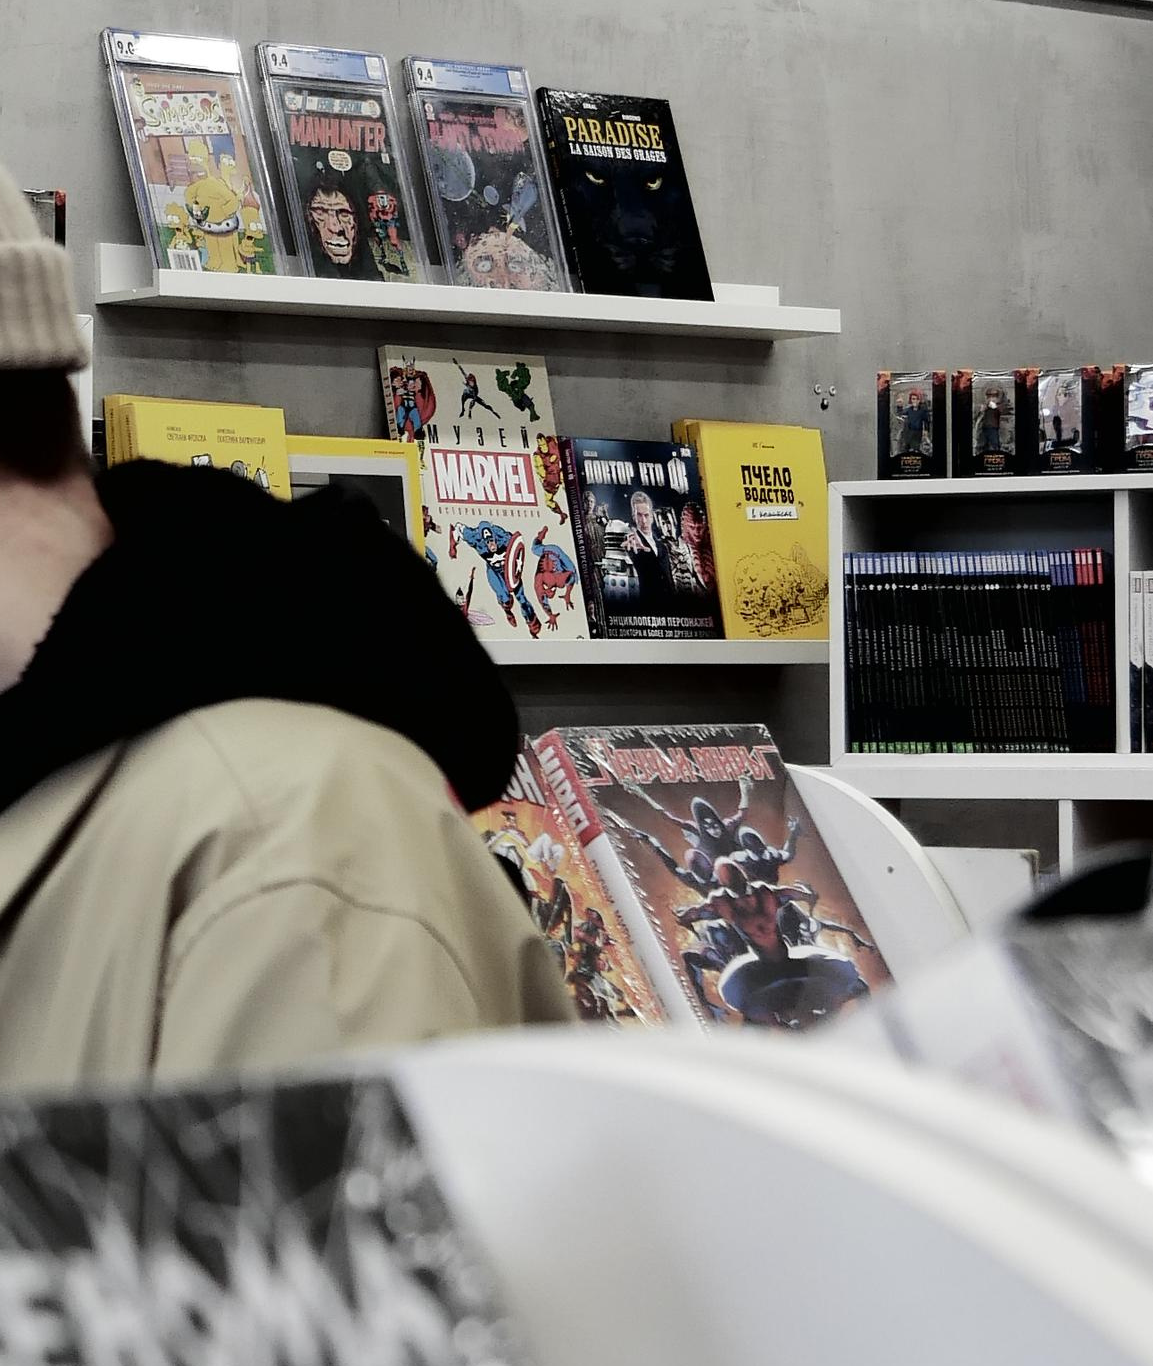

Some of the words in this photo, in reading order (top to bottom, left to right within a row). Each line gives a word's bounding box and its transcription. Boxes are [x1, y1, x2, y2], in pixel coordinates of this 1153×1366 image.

[271, 53, 288, 68] 9.4
[417, 67, 433, 82] 9.4
[289, 115, 387, 153] MANHUNTER
[563, 116, 664, 150] PARADISE
[569, 142, 583, 156] LA
[583, 144, 614, 159] SAISON
[614, 146, 633, 160] DES
[427, 423, 530, 449] МУЗЕЙ
[432, 452, 537, 504] MARVEL
[584, 460, 635, 486] ДОКТОР
[638, 461, 666, 488] КТО
[740, 464, 792, 488] ПЧЕЛО
[743, 487, 795, 504] ВОДСТВО
[608, 615, 667, 628] ЭНЦИКЛОПЕДИЯ
[668, 616, 716, 629] ПЕРСОНАЖЕЙ
[535, 744, 591, 836] MARVEL
